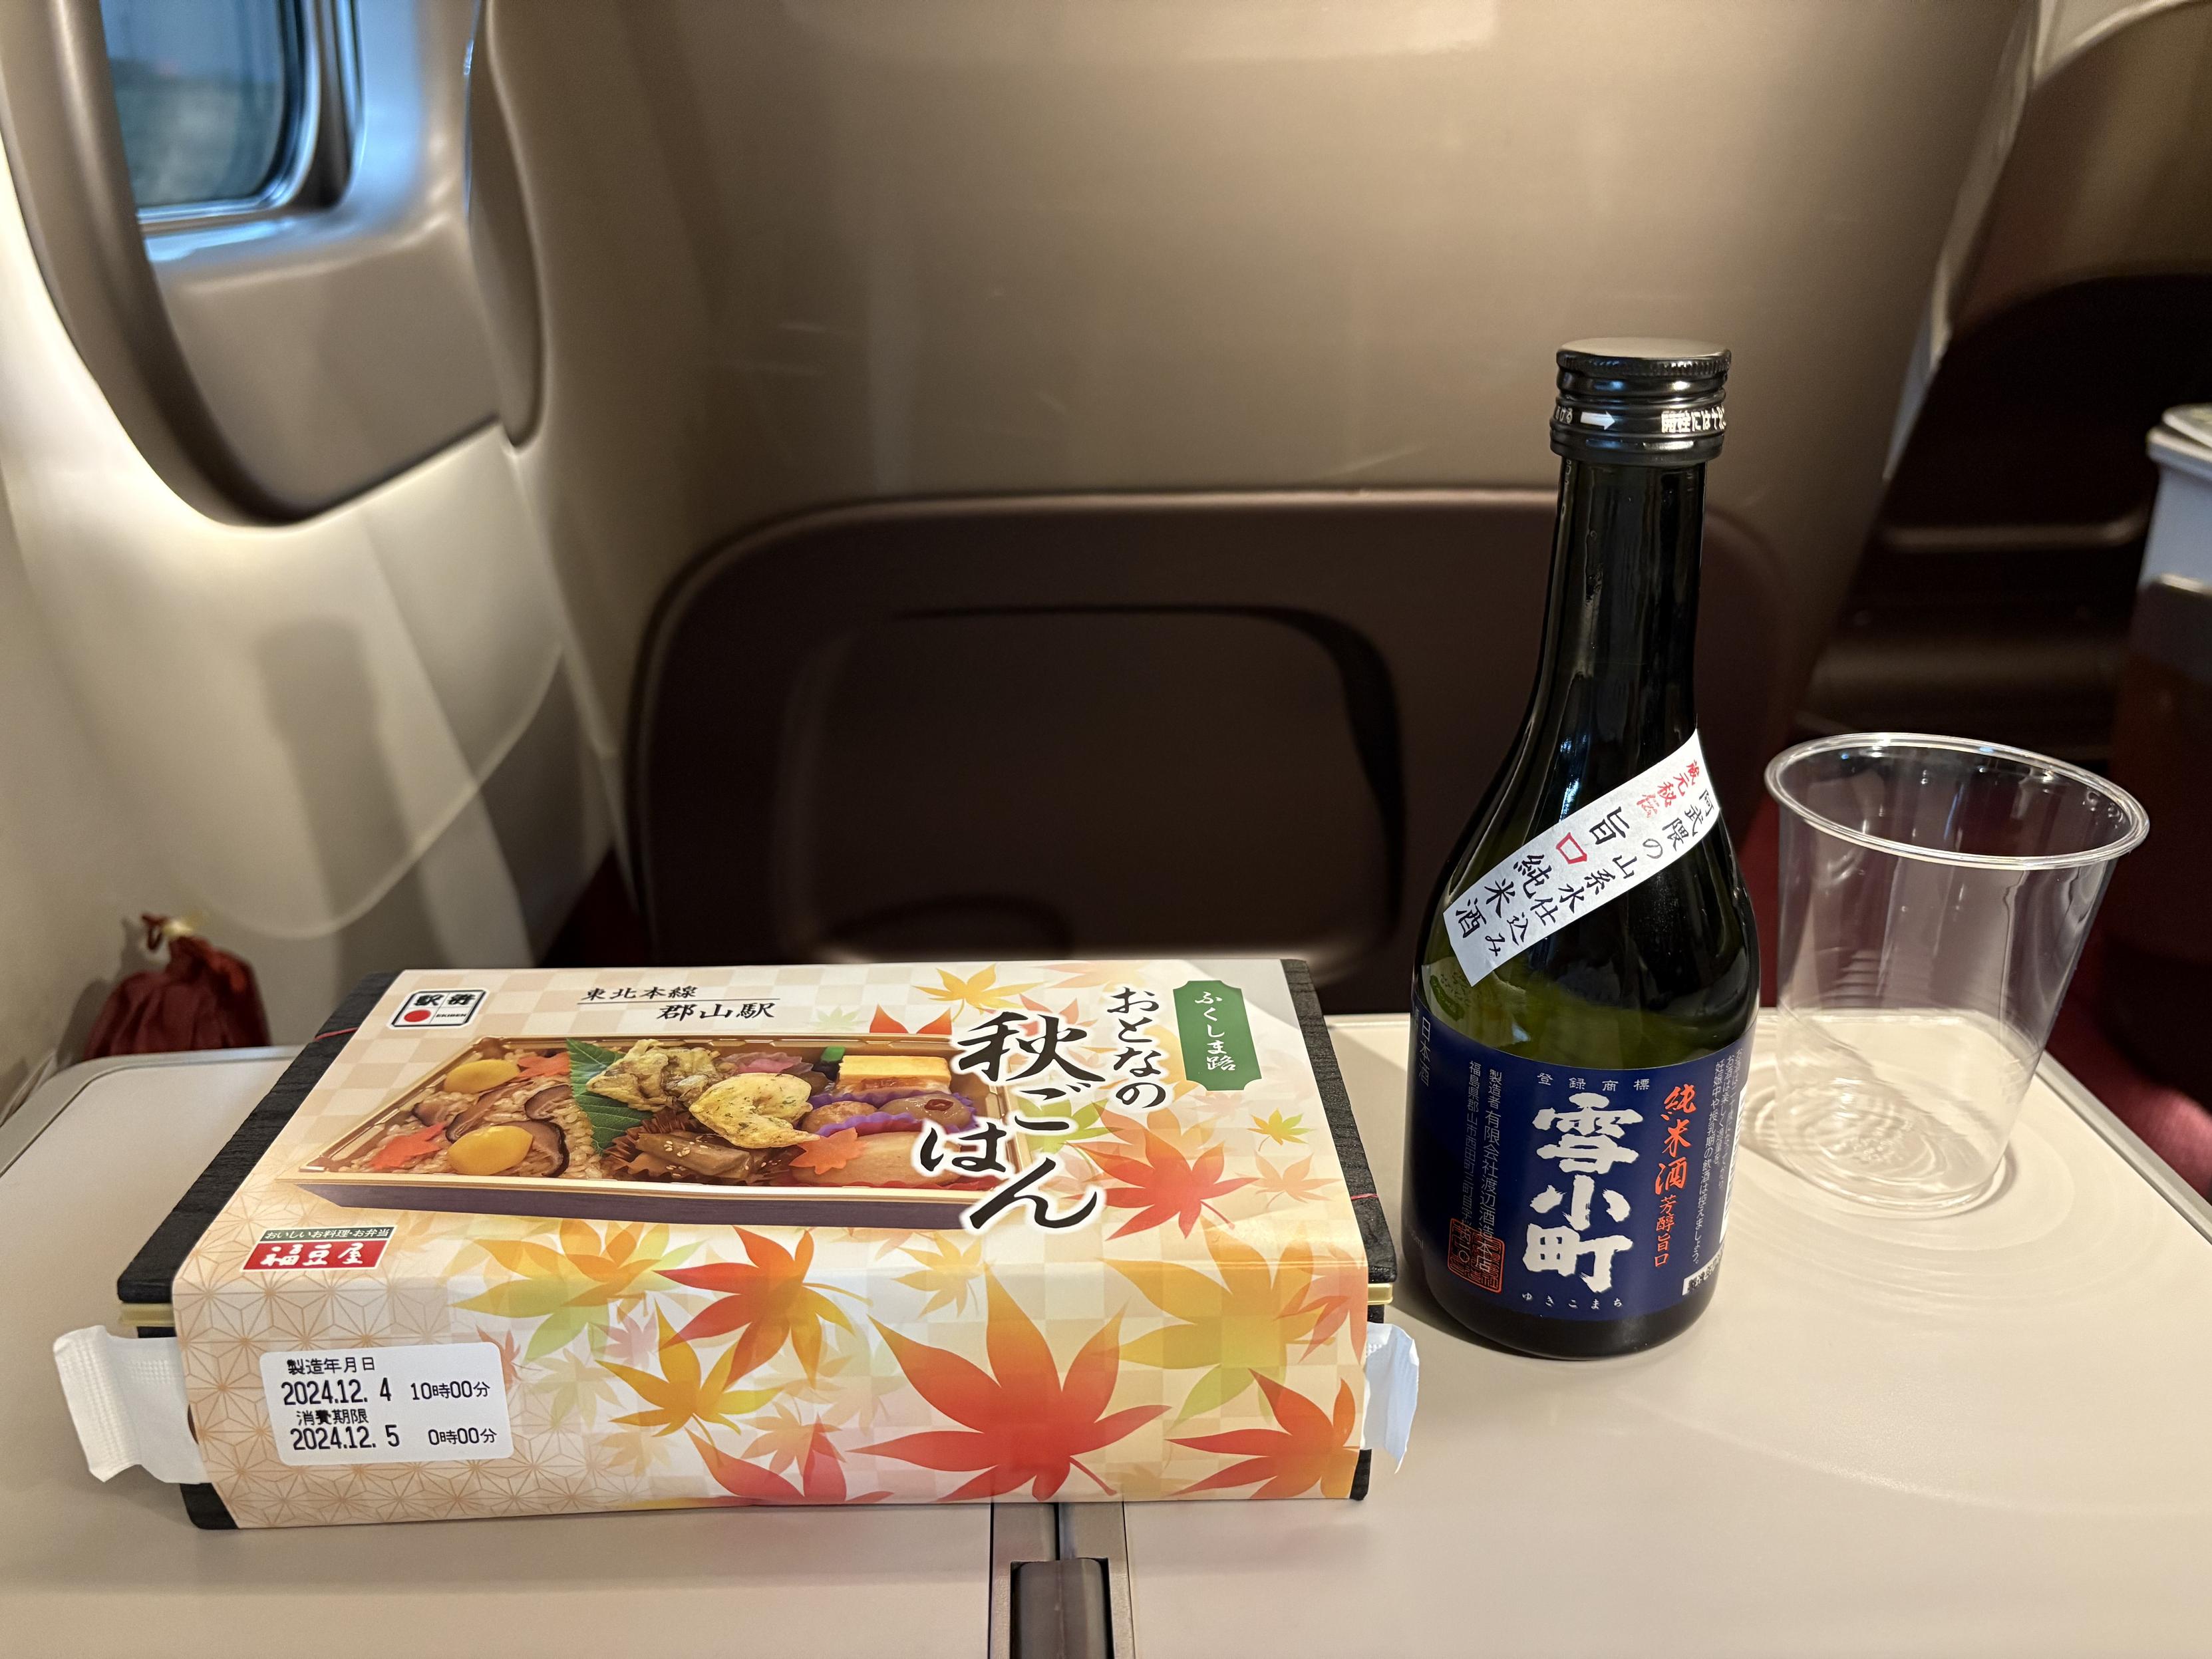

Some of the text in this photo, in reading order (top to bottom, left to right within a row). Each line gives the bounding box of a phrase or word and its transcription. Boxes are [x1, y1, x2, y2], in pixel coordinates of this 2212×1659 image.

[586, 986, 697, 1000] 東北本線
[656, 1002, 776, 1022] 郡山駅
[1195, 991, 1236, 1072] ふくしま路
[1107, 987, 1166, 1109] おとなの
[1418, 1016, 1431, 1087] 日本酒
[1537, 1072, 1651, 1092] 登録商標
[919, 1011, 1106, 1229] 秋ごはん
[1522, 1092, 1643, 1293] 雪小町
[259, 1243, 365, 1267] 福豆屋
[1522, 1292, 1623, 1310] ゆきこまち
[287, 1357, 376, 1375] 製造年月日
[281, 1378, 490, 1405] 2024.12. 4 10時00分
[296, 1409, 369, 1426] 消費期限
[290, 1425, 498, 1450] 2024.12. 5 0時00分
